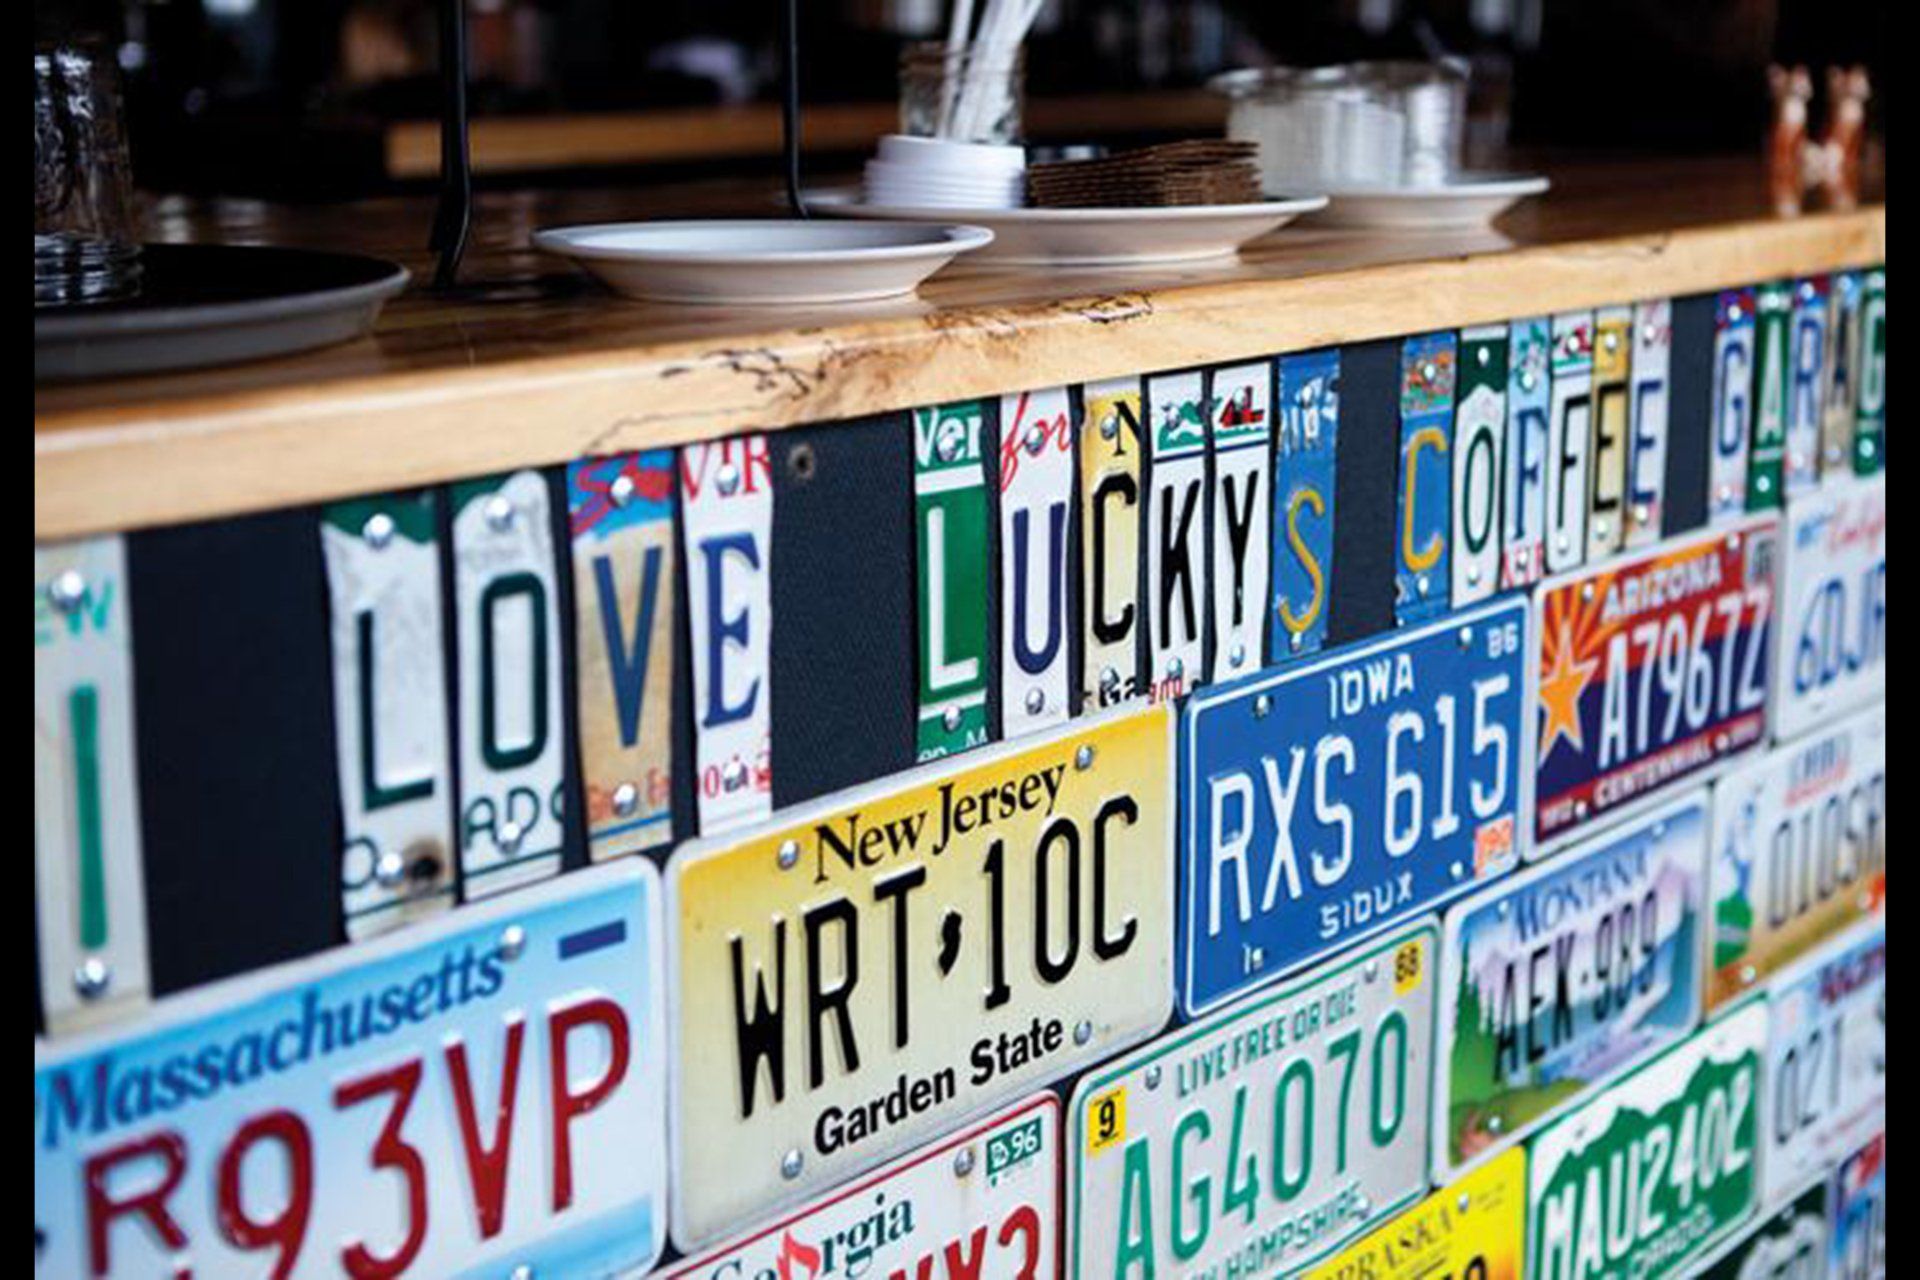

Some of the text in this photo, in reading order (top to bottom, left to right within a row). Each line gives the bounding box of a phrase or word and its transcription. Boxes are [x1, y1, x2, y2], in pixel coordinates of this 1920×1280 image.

[69, 683, 104, 948] I
[357, 531, 761, 812] LOVE
[927, 469, 1325, 692] LUCKYS
[1401, 379, 1662, 573] COFFEE
[1328, 653, 1414, 720] IOWA
[813, 763, 1067, 883] New Jersey
[1208, 673, 1510, 938] RXS 615
[1319, 872, 1413, 939] SIOUX
[40, 945, 506, 1150] Massachusetts
[729, 867, 927, 1120] WRT
[1176, 981, 1356, 1098] LIVE FREE OR DIE
[814, 1018, 1064, 1156] Garden State
[1011, 1124, 1039, 1160] 96
[1099, 1099, 1117, 1139] 9
[1112, 1010, 1408, 1280] AG4070
